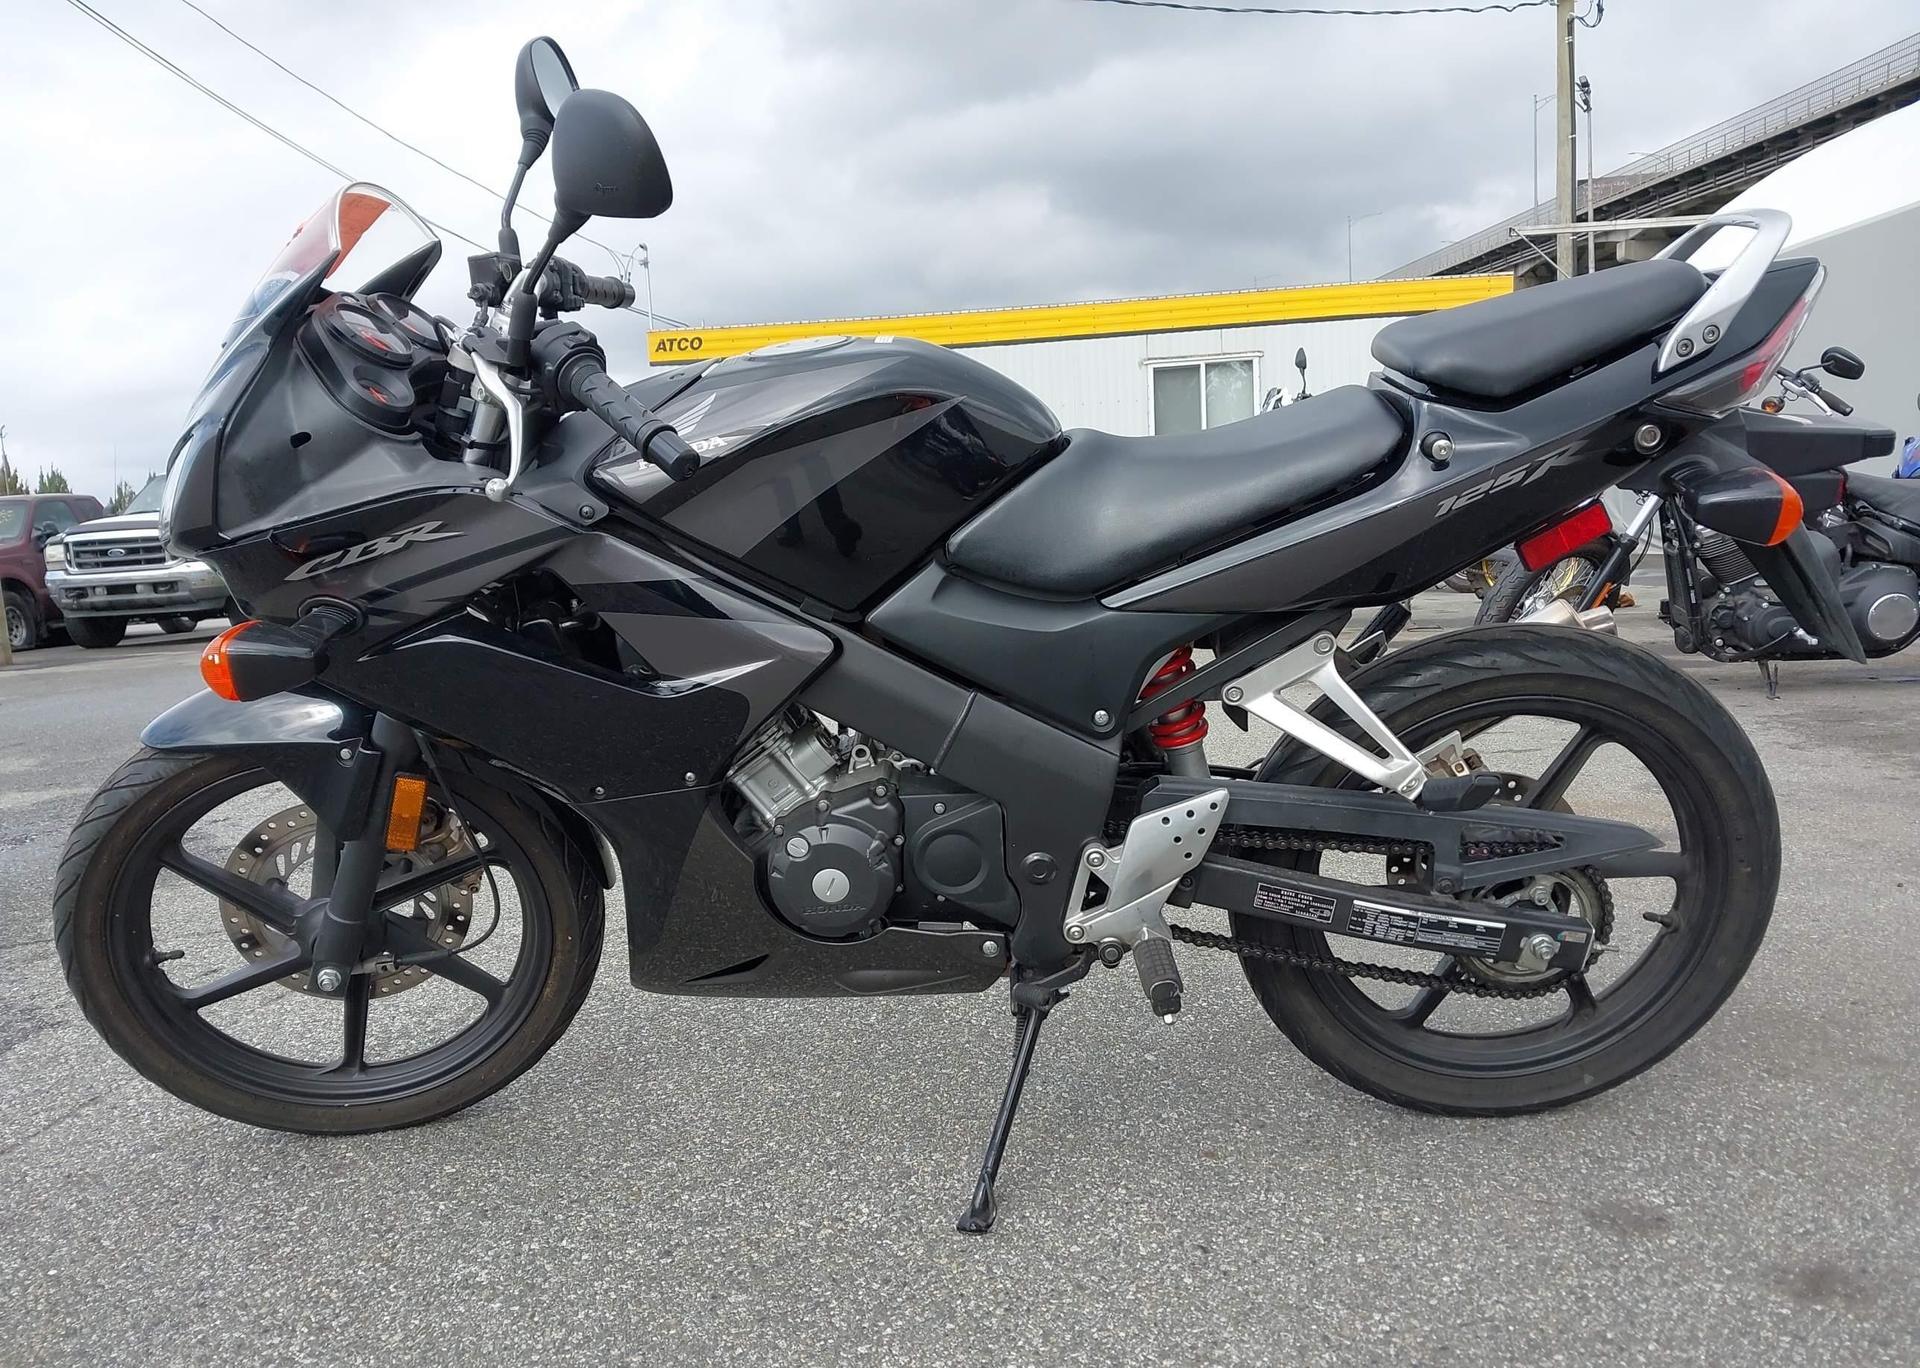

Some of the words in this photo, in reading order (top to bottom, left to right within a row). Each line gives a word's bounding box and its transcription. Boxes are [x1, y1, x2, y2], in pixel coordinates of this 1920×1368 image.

[654, 336, 703, 353] ATCO
[1434, 439, 1590, 518] 125R
[284, 520, 465, 582] CBR
[803, 903, 867, 915] HONDA
